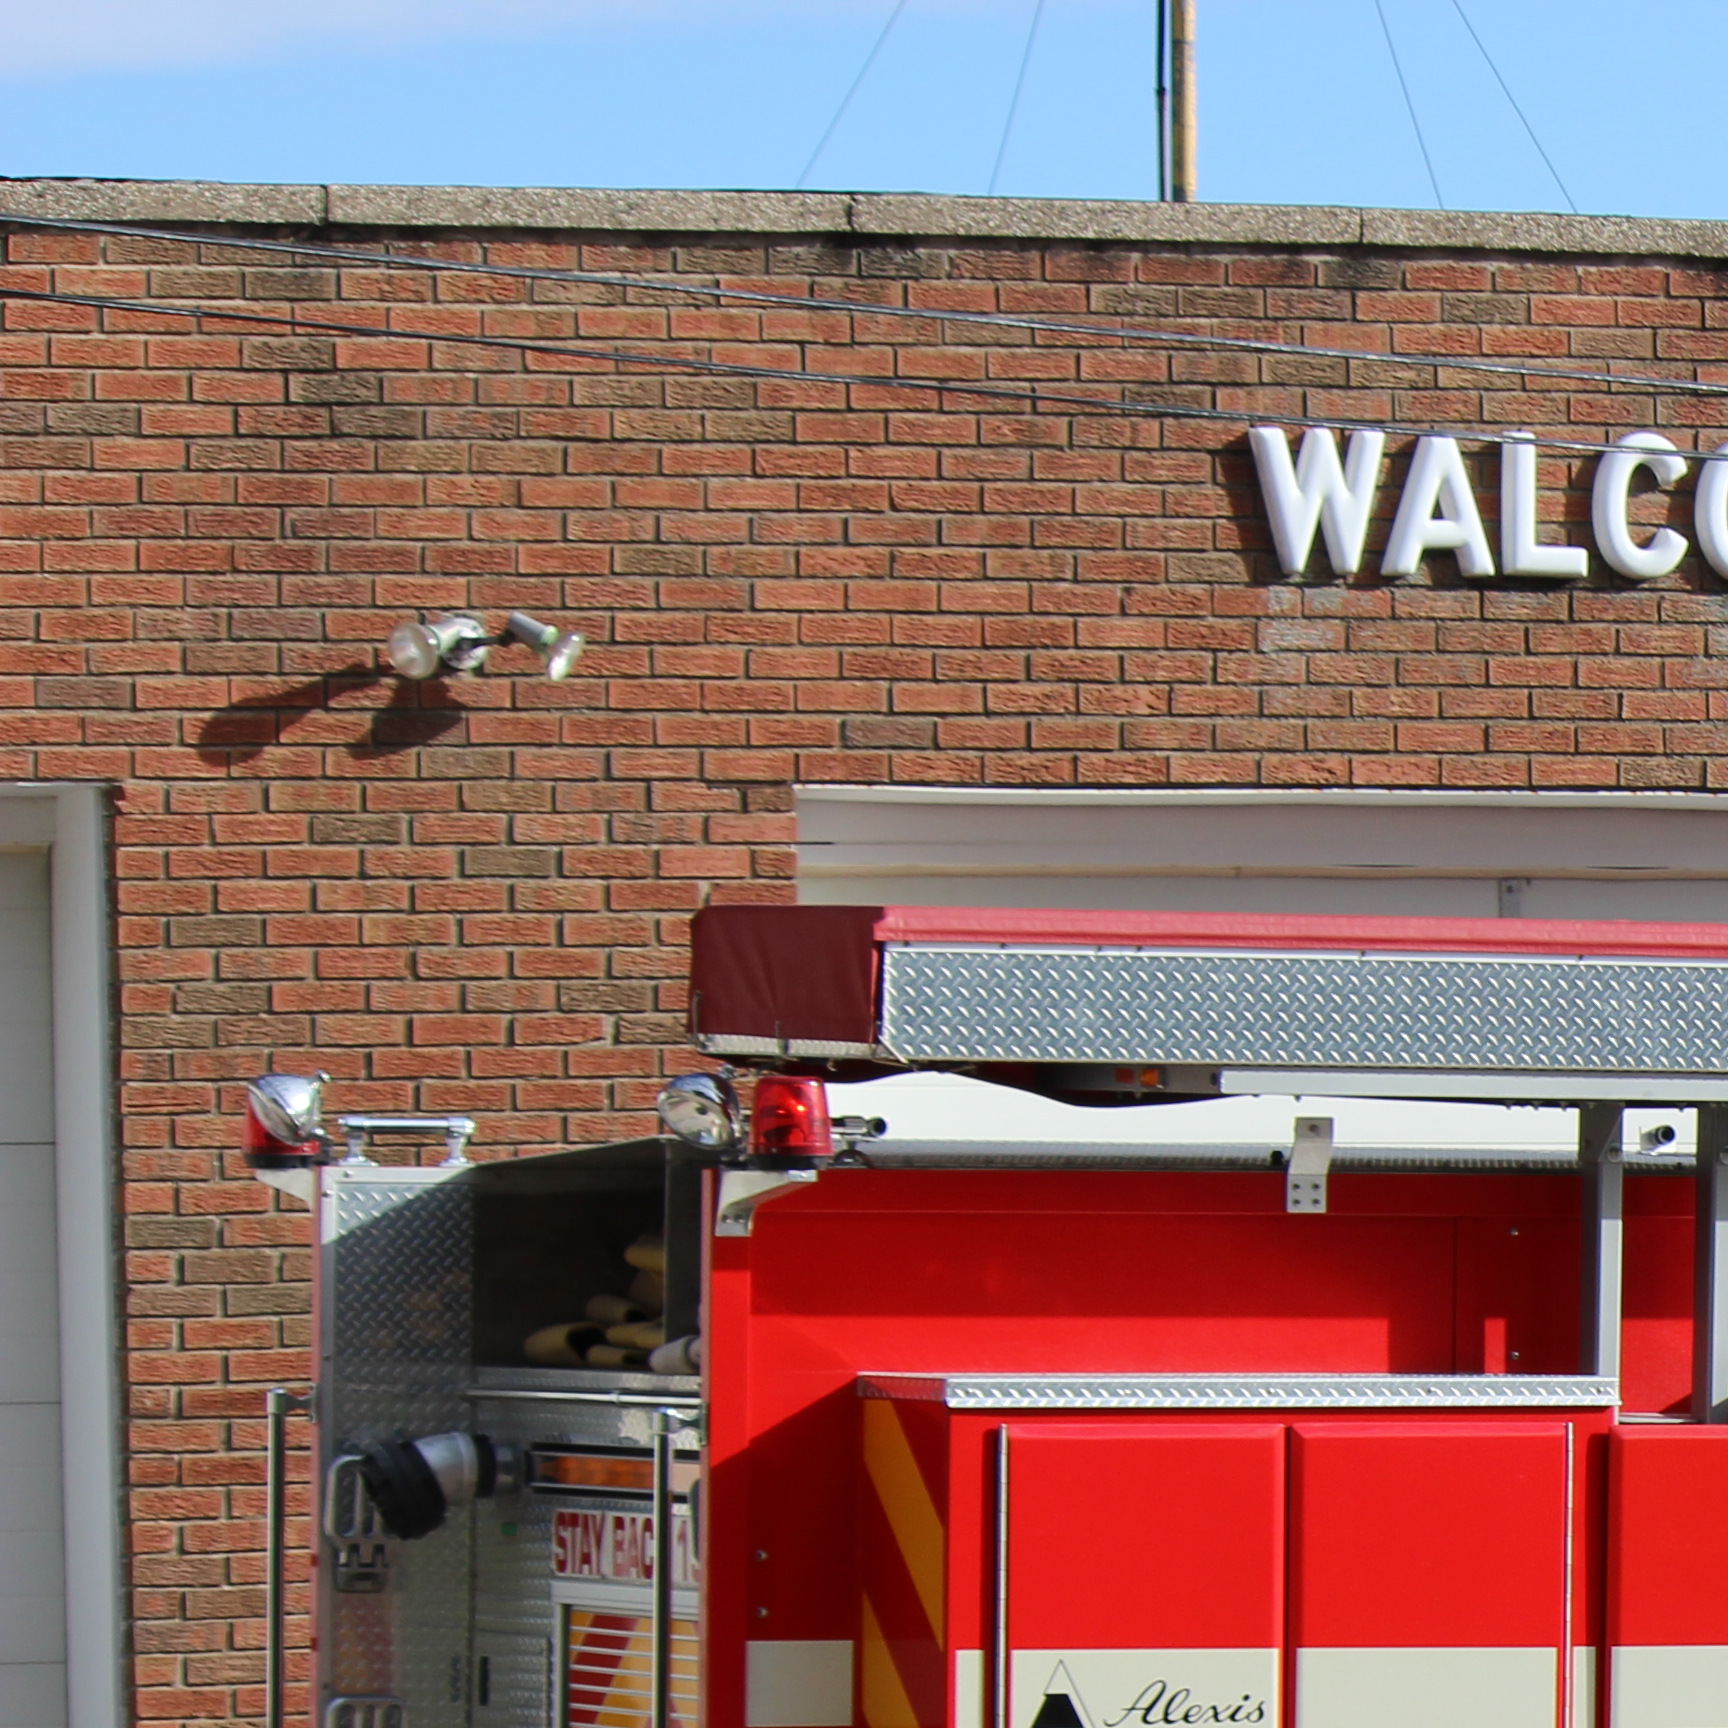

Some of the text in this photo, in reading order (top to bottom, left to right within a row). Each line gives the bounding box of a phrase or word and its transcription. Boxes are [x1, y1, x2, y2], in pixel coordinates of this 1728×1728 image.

[553, 1511, 602, 1575] STAY
[611, 1515, 655, 1580] BAC
[1102, 1679, 1266, 1728] Alexis
